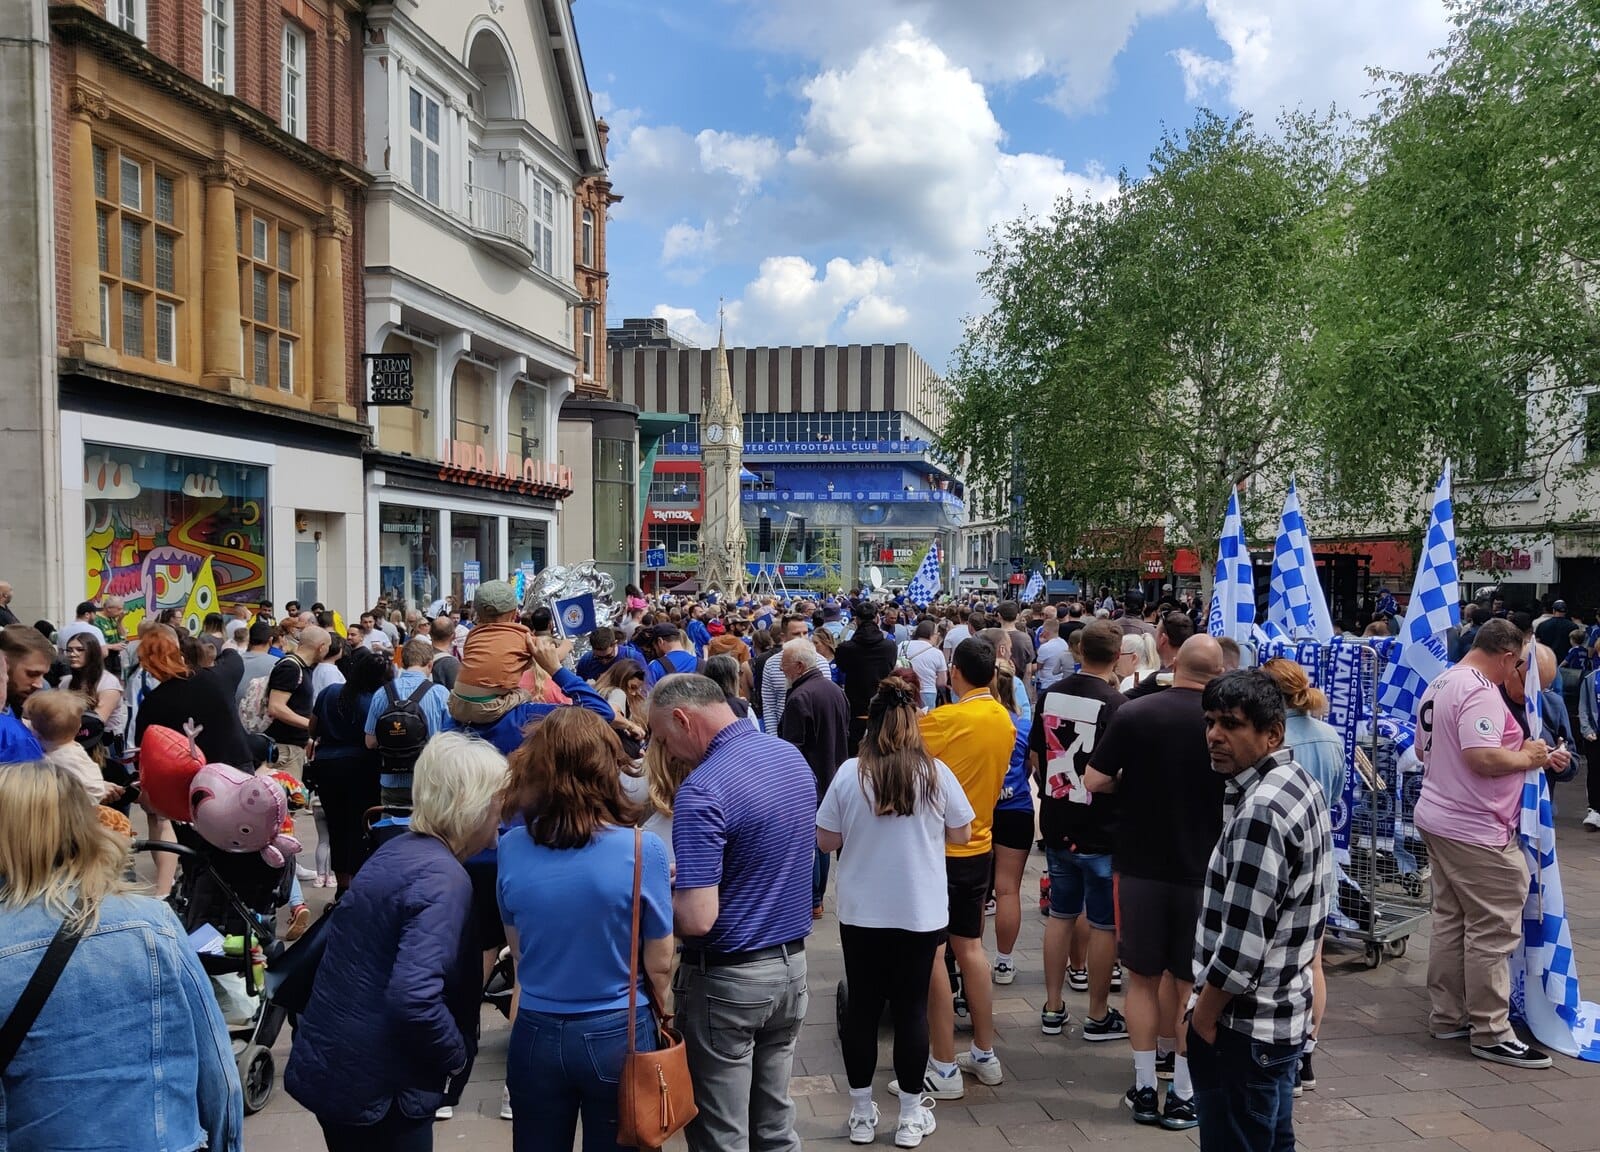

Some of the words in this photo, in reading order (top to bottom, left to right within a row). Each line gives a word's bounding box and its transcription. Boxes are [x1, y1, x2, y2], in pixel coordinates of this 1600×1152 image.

[768, 443, 791, 451] CITY
[795, 443, 848, 451] FOOTBALL
[1347, 659, 1360, 731] LEICESTER
[1345, 731, 1354, 760] CITY
[1344, 764, 1352, 791] 2024
